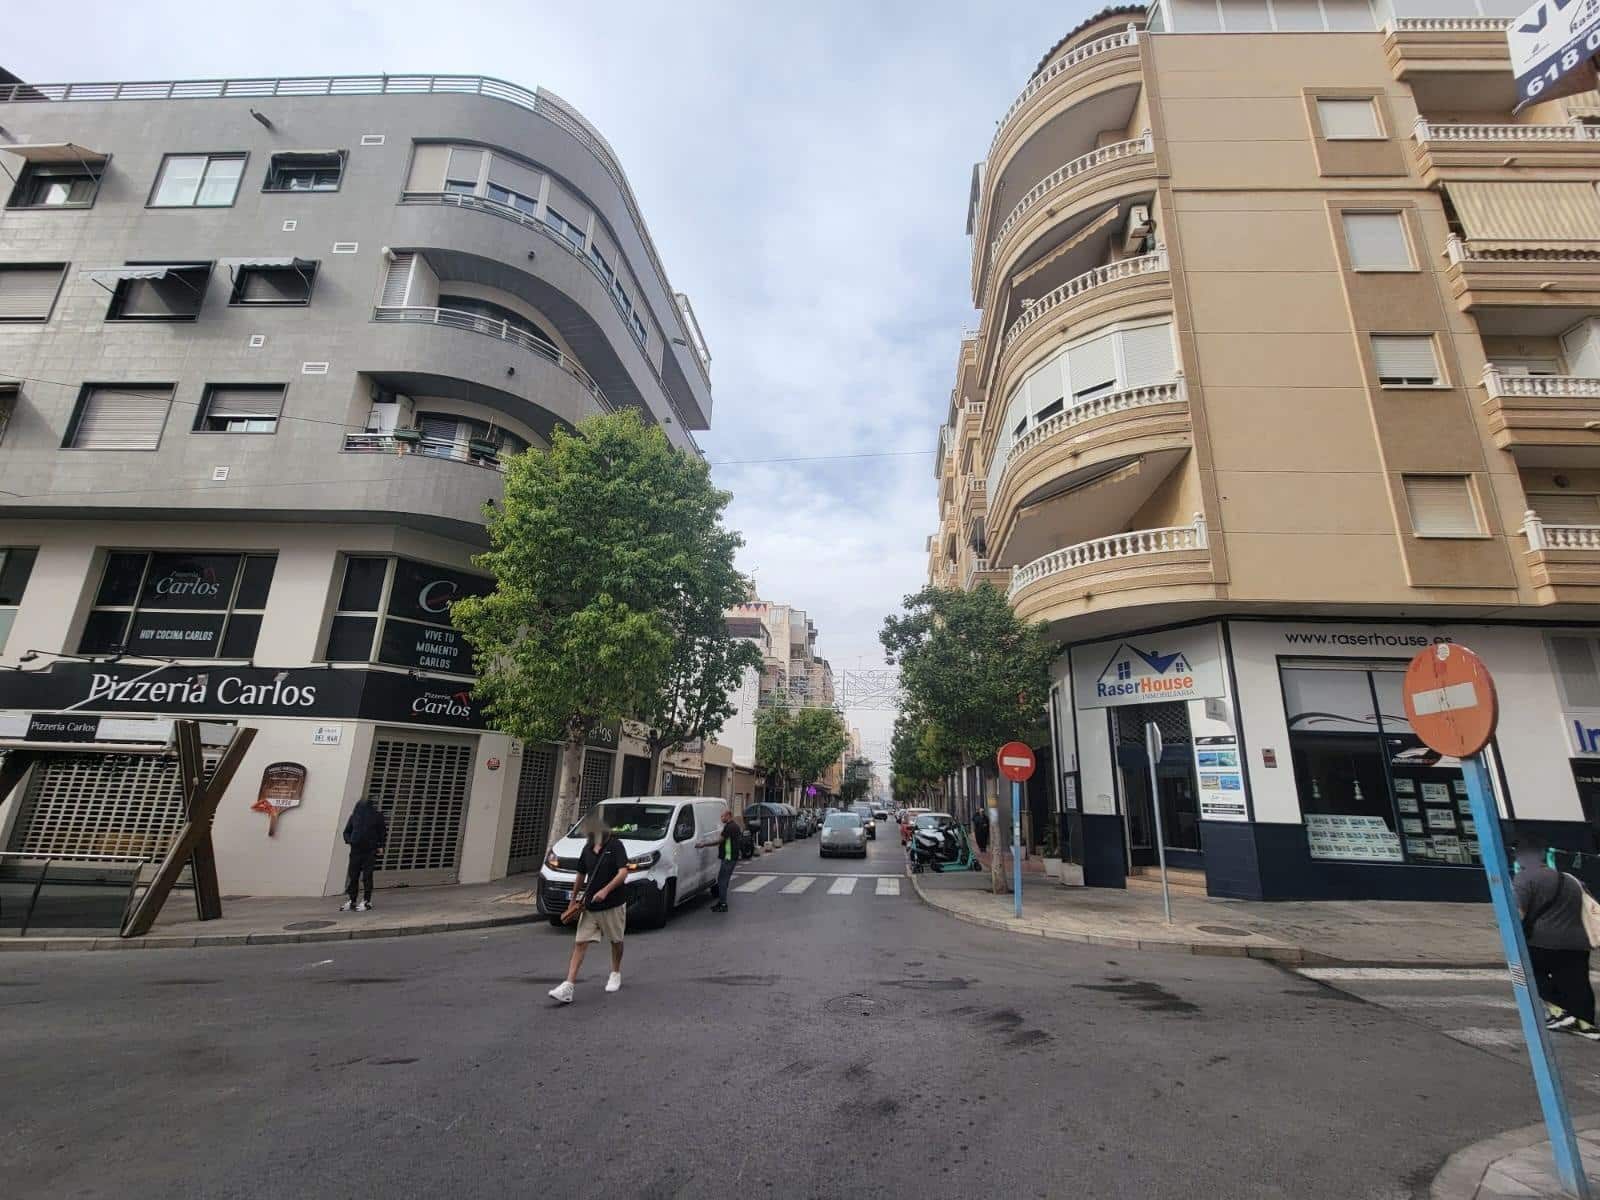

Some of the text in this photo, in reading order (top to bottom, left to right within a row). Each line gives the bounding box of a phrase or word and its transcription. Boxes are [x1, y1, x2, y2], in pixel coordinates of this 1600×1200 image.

[1526, 48, 1579, 97] 618
[156, 577, 220, 595] Carlos
[185, 631, 214, 640] CARLOS
[425, 630, 455, 643] VIVE TU
[416, 641, 458, 657] MOMENTO
[420, 656, 450, 669] CARLOS
[217, 676, 316, 706] Carlos
[1097, 676, 1193, 697] RaserHouse
[412, 697, 471, 717] Carlos
[66, 722, 96, 732] Carlos
